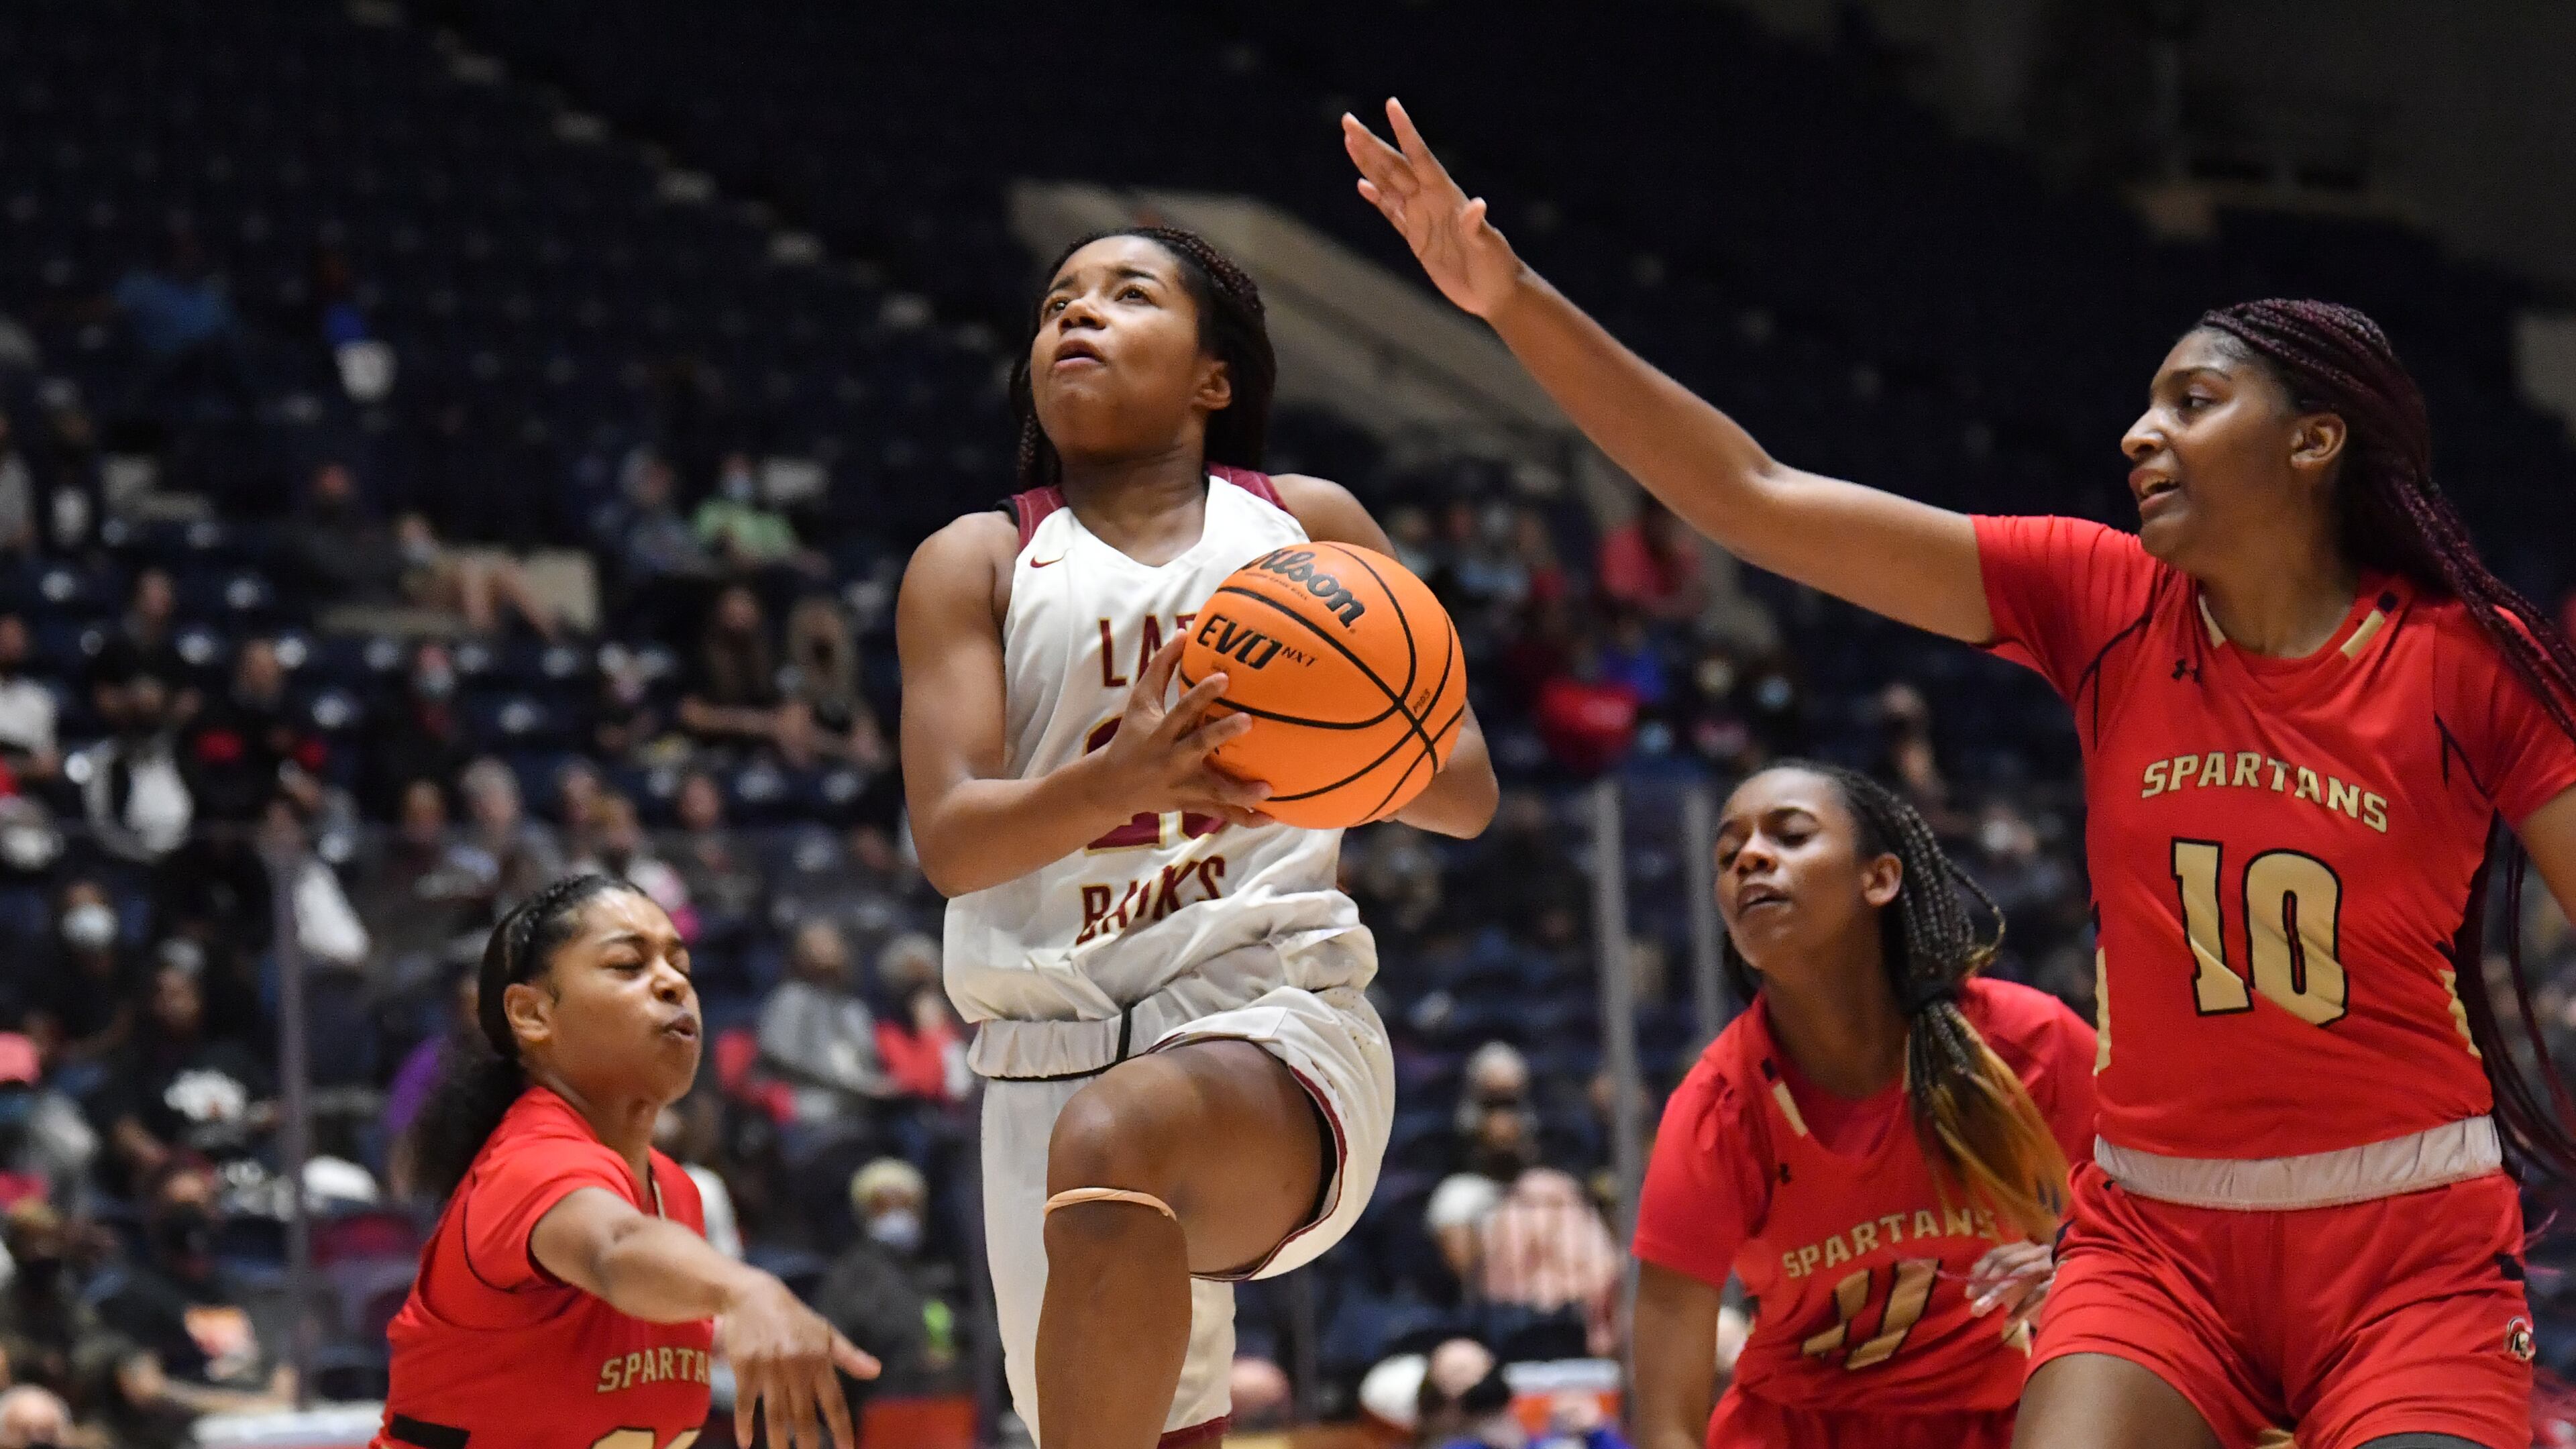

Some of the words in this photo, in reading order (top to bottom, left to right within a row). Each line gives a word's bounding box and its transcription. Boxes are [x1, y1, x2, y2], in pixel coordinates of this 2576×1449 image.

[1196, 613, 1283, 670] EVO
[1281, 645, 1318, 667] NXT
[2141, 751, 2388, 833] SPARTANS
[2171, 836, 2349, 1028] 10
[596, 1346, 711, 1393] SPARTA
